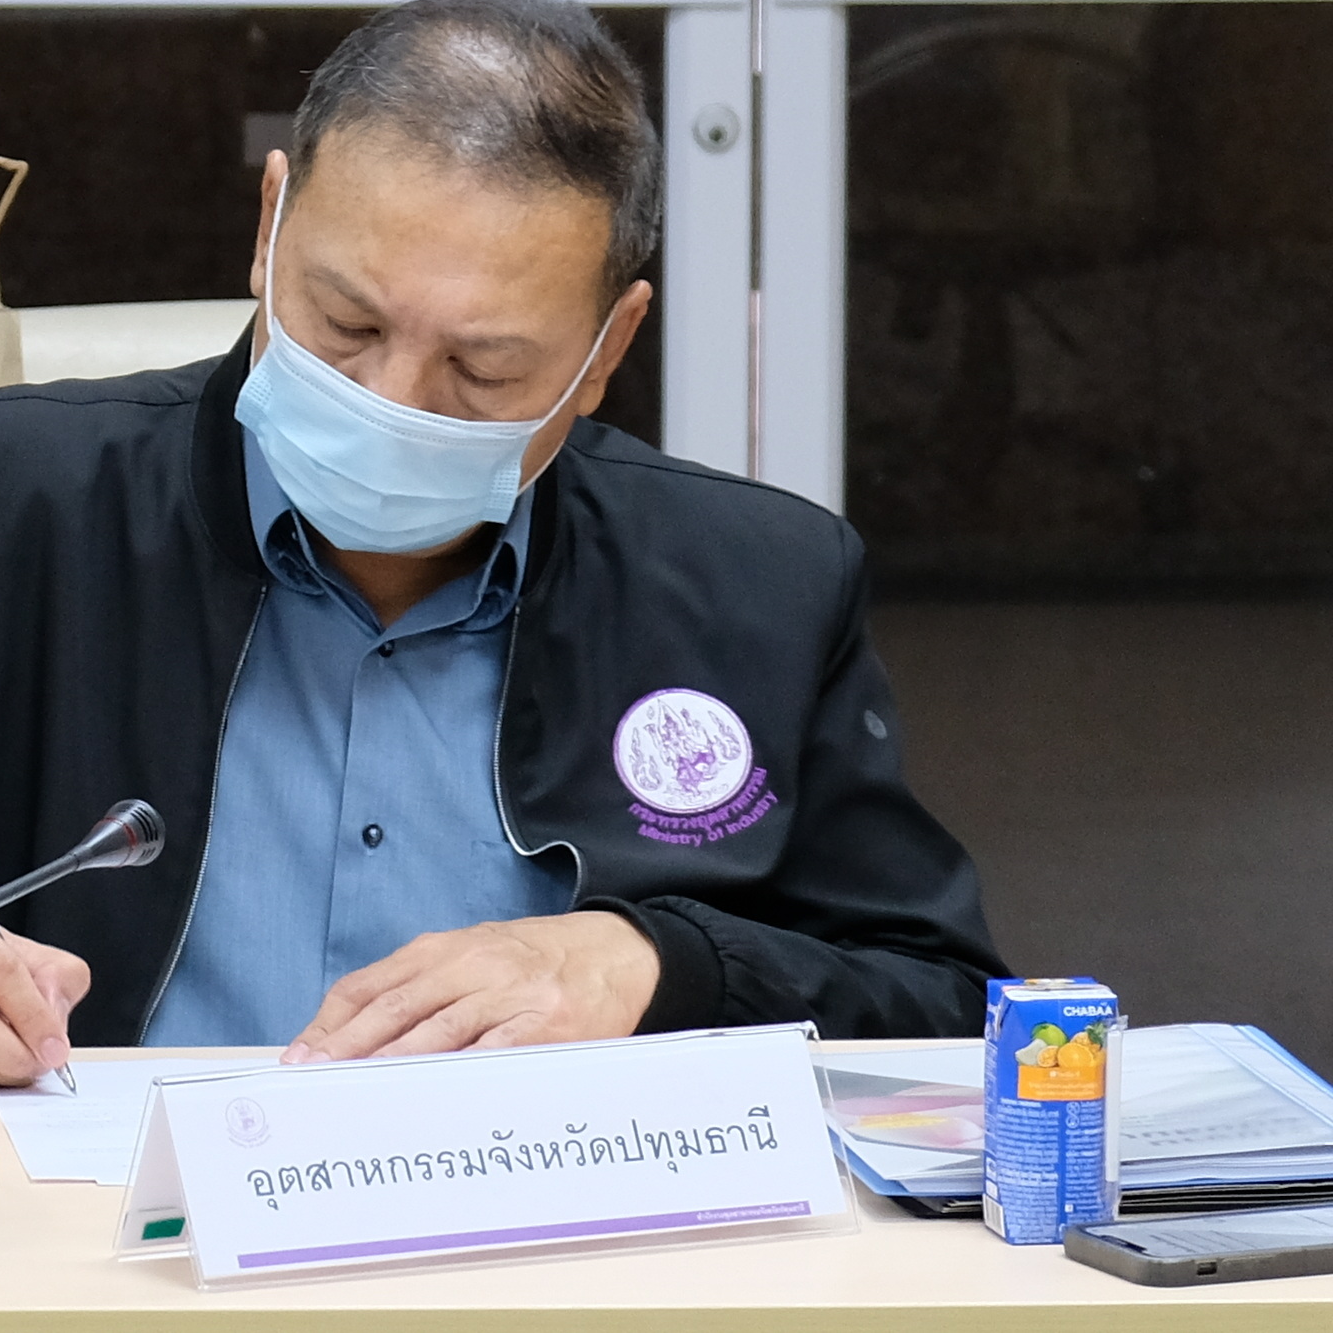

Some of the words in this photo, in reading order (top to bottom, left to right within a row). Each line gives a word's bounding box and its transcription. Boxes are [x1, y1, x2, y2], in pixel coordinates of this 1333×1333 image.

[637, 823, 703, 848] Ministry
[707, 828, 725, 842] of
[725, 790, 779, 835] Industry
[246, 1104, 779, 1212] อุตสาหกรรมจังหวัดปทุมธานี
